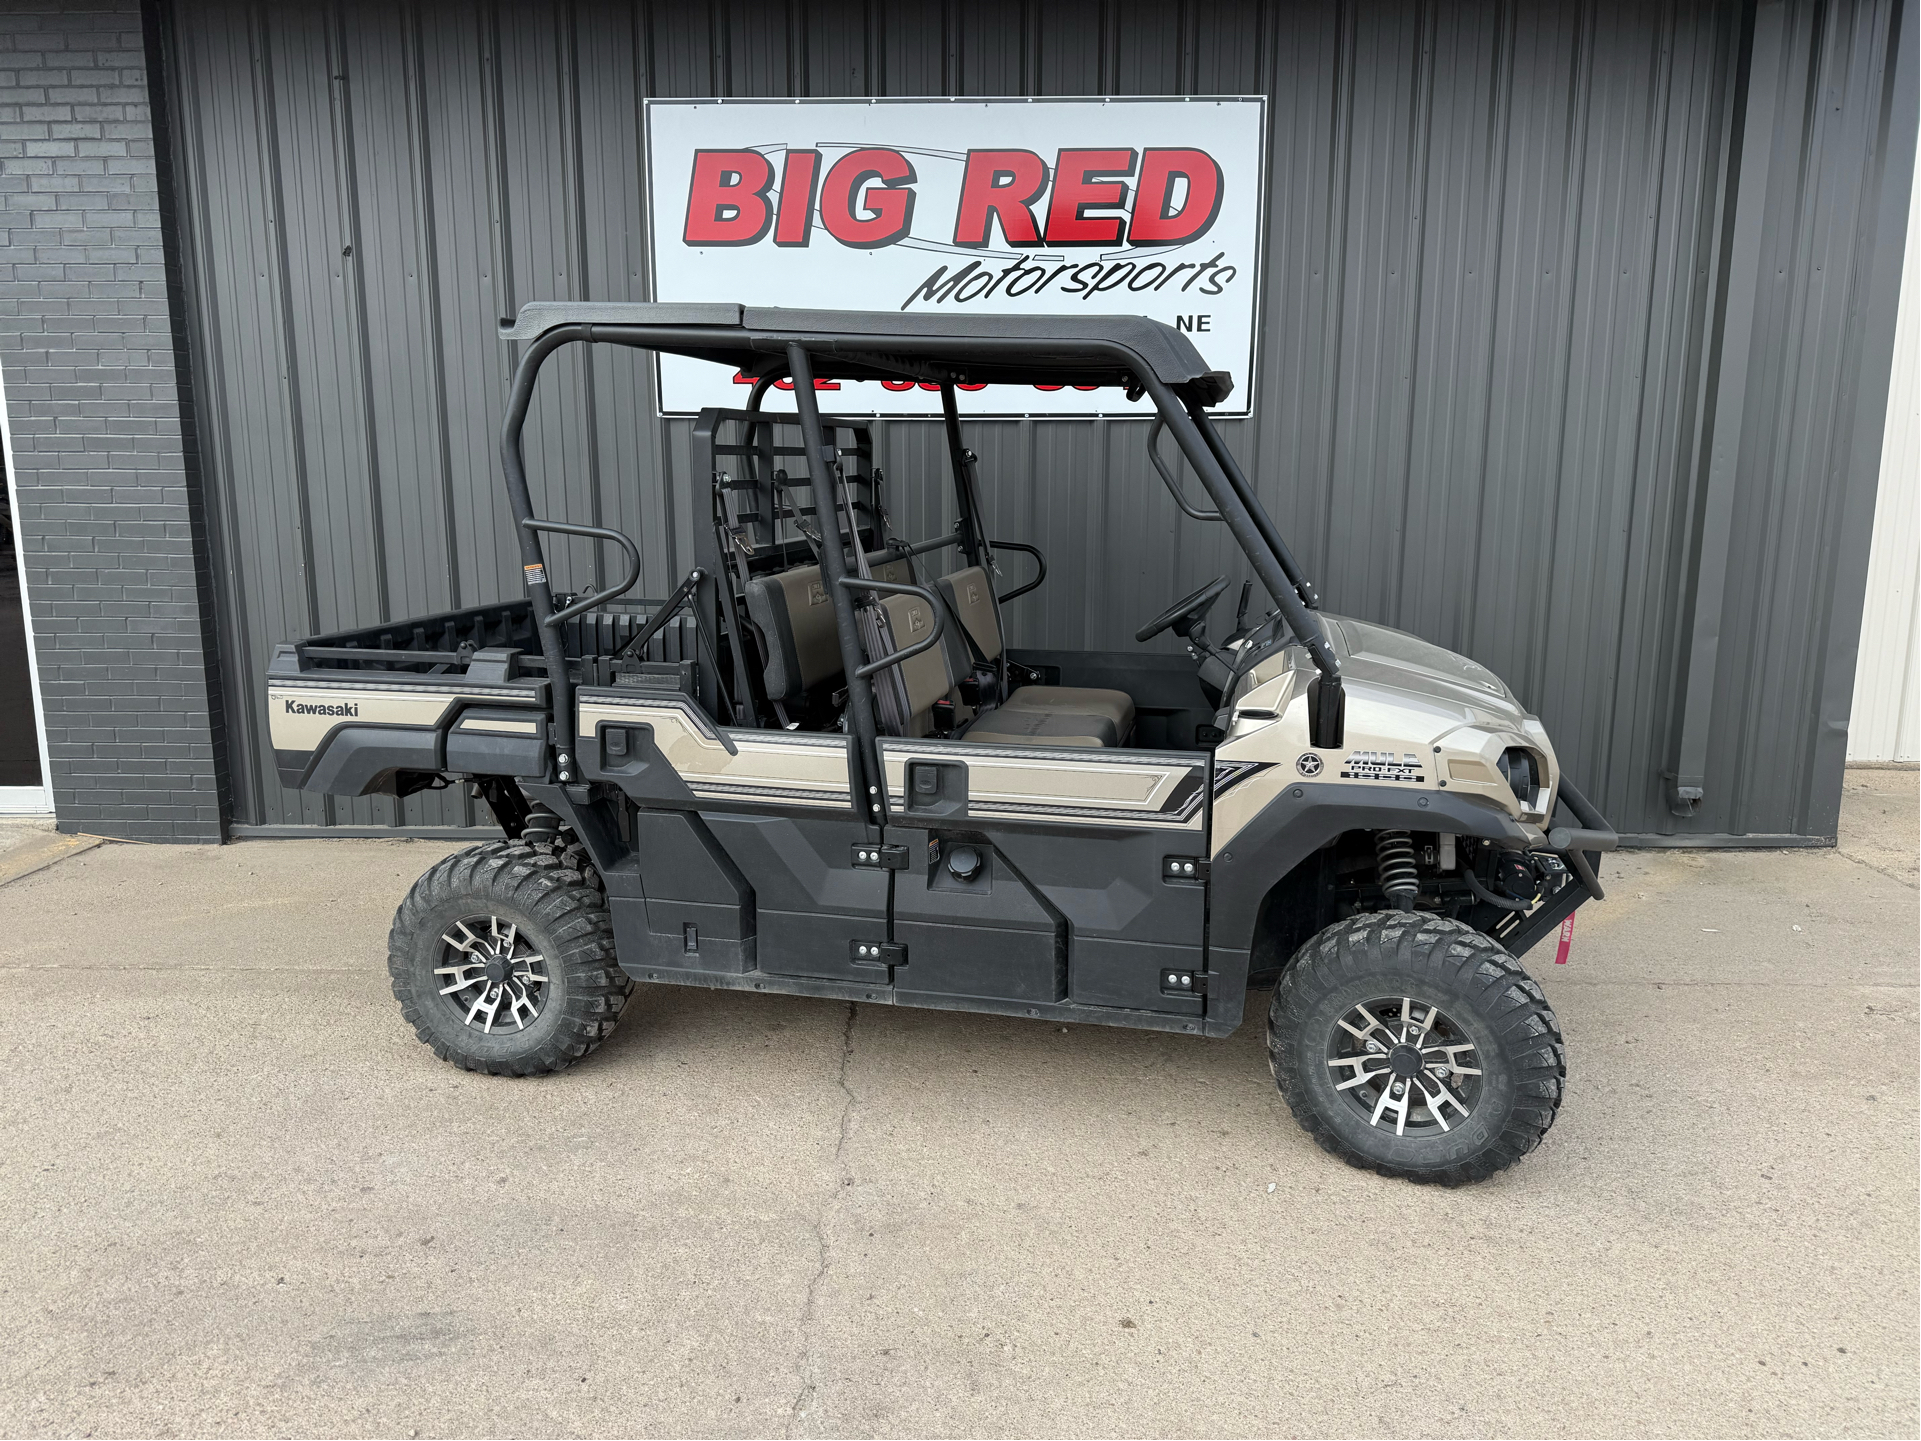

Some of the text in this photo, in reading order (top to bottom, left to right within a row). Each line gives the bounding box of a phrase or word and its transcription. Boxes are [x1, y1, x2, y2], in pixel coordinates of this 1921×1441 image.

[682, 147, 1225, 248] BIG RED
[900, 251, 1237, 312] Motorsports
[1176, 314, 1211, 332] NE
[285, 699, 359, 717] Kawasaki
[1343, 750, 1423, 768] MULE
[1349, 772, 1418, 782] 1000
[1350, 765, 1416, 774] PRO-FXT
[1561, 919, 1572, 942] WARN
